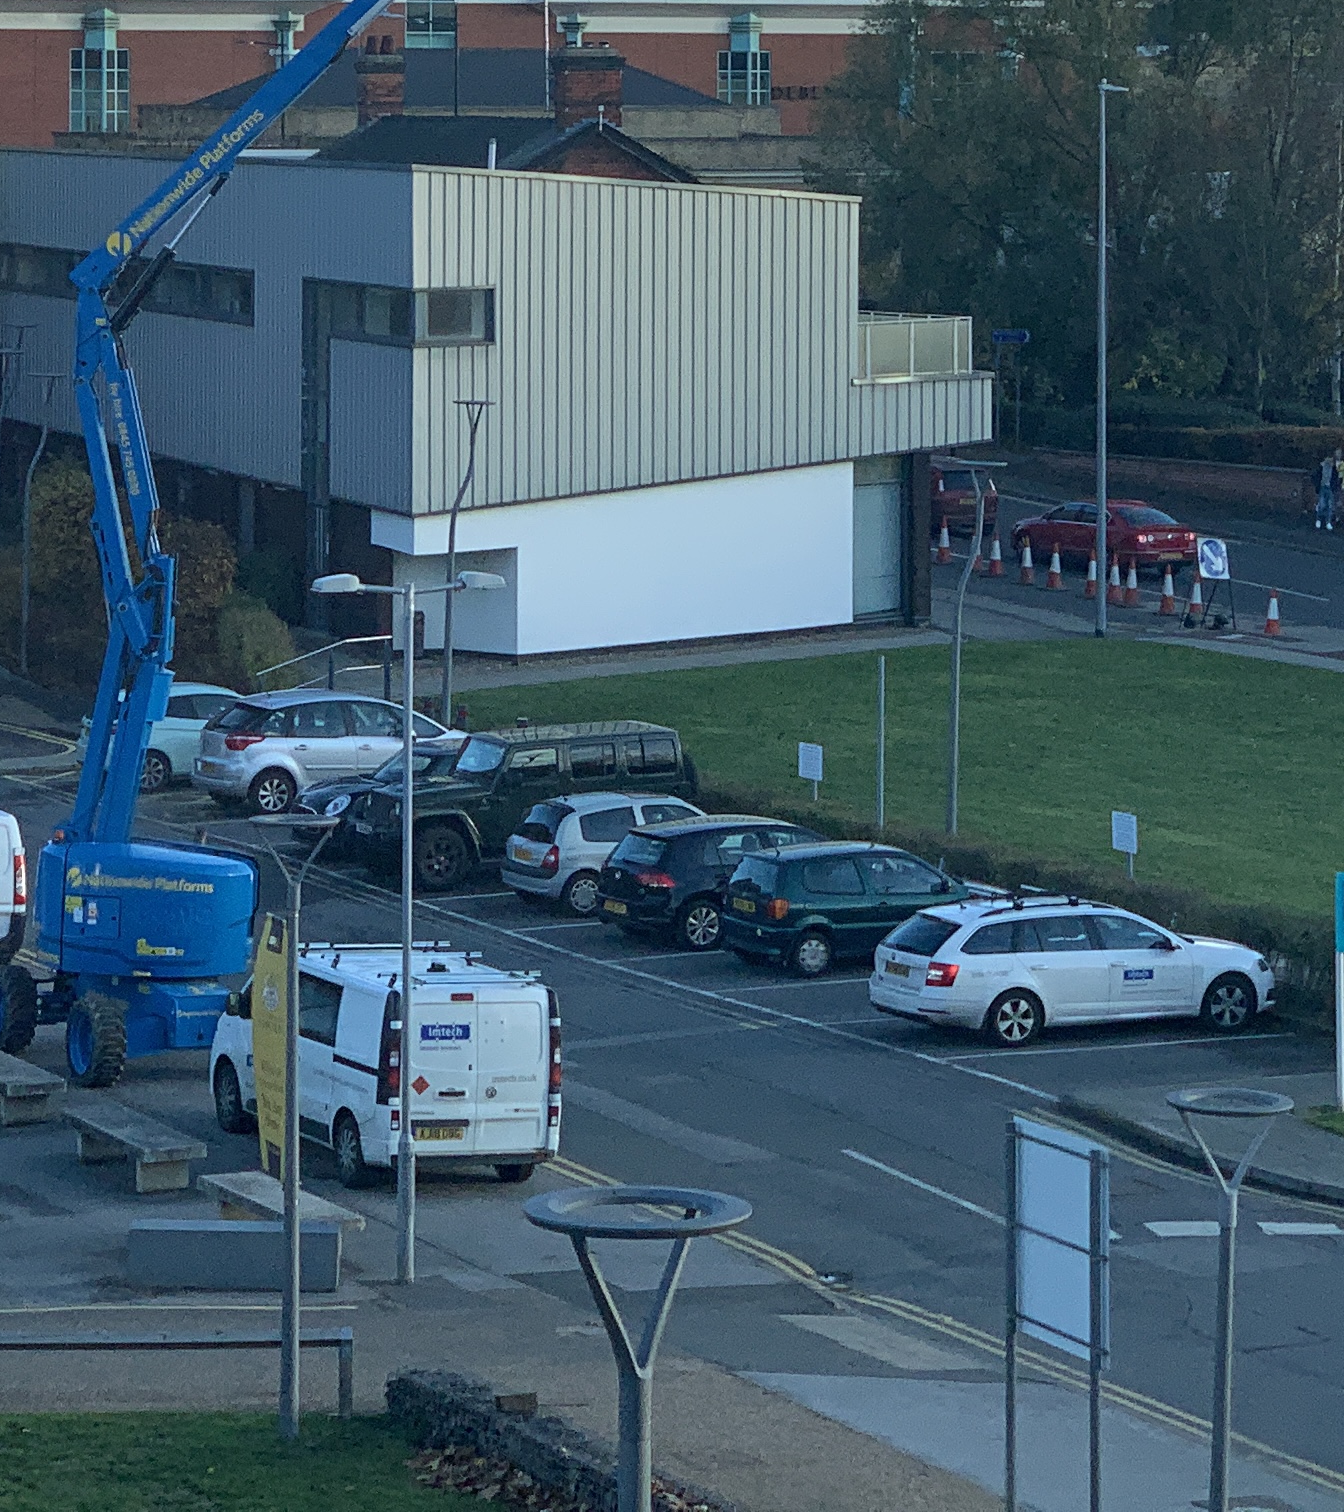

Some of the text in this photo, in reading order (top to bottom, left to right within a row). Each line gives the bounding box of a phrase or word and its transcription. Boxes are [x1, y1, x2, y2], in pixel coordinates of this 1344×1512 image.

[129, 109, 264, 237] Nationwide Platforms
[153, 877, 214, 893] Platforms
[428, 1027, 463, 1037] Imtech
